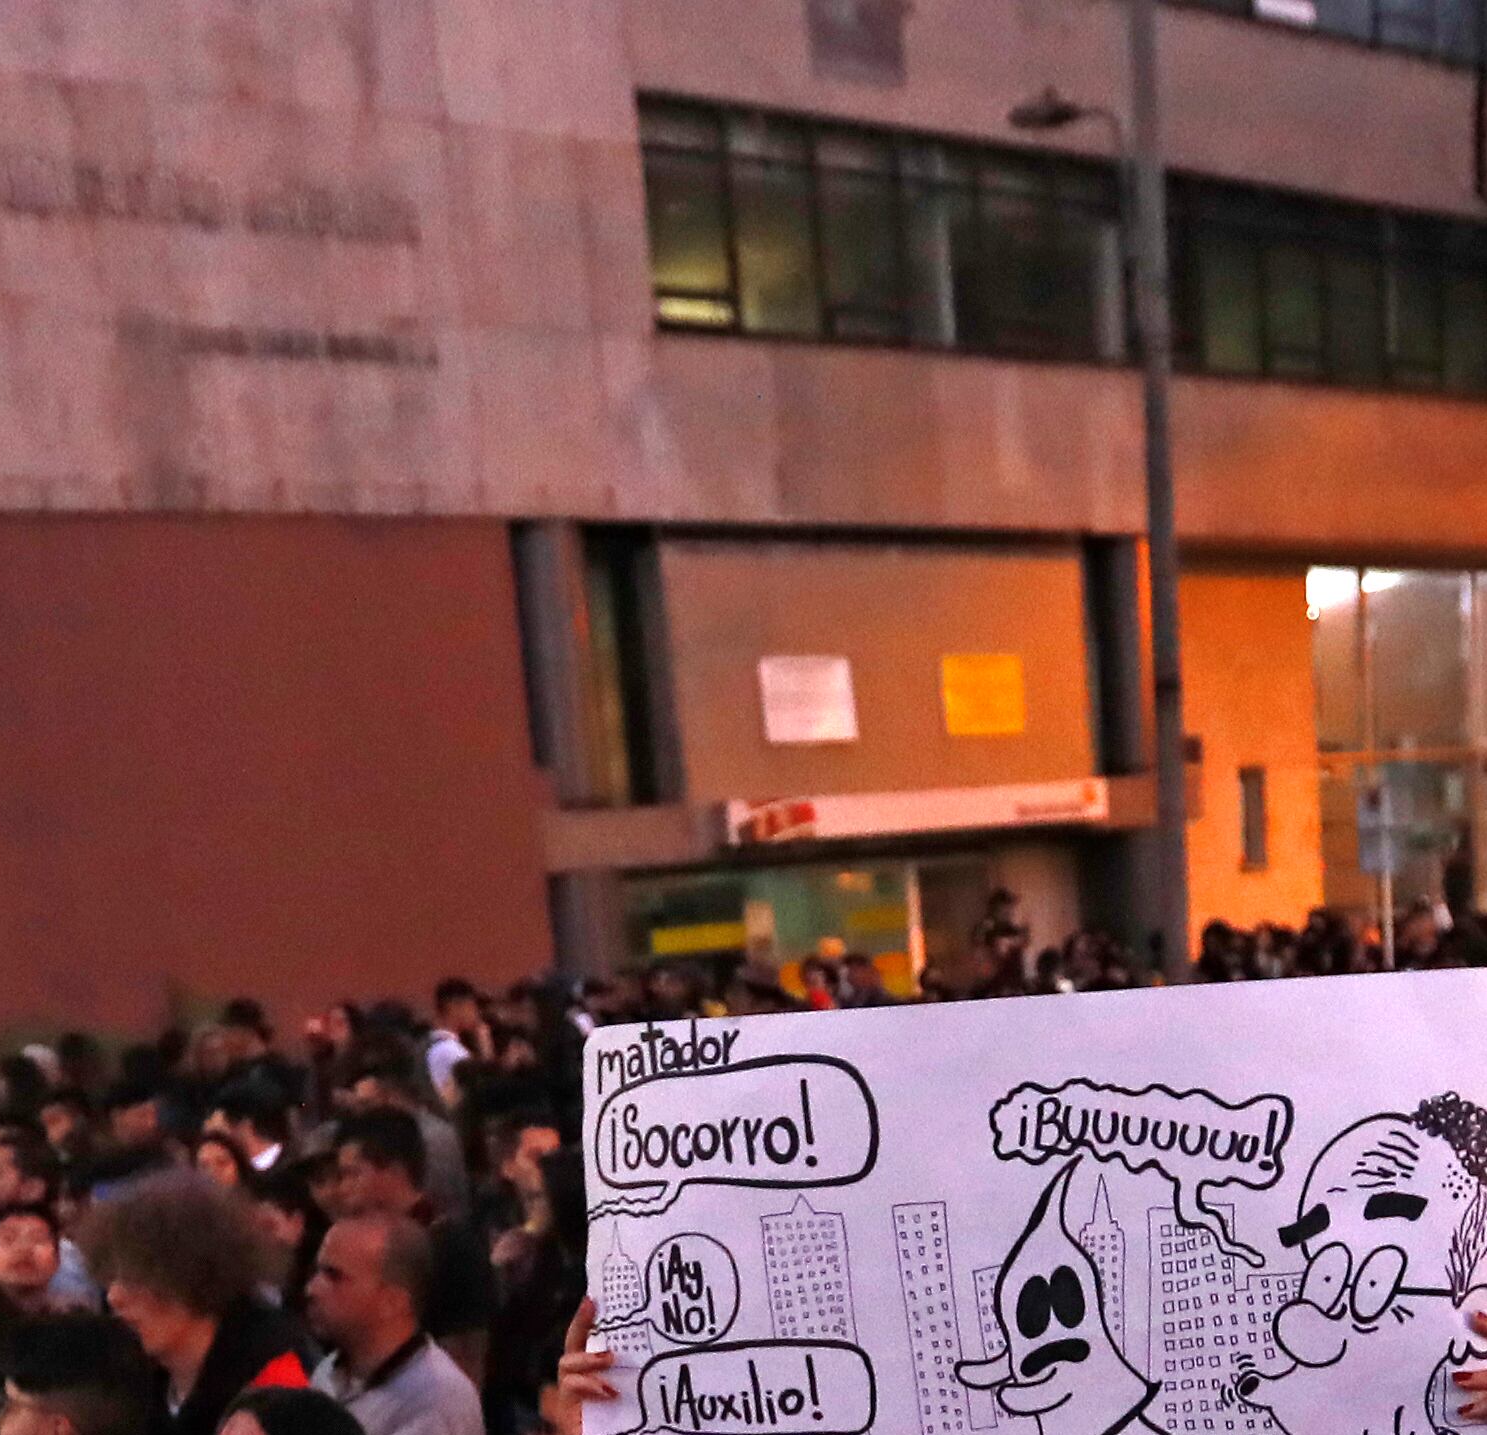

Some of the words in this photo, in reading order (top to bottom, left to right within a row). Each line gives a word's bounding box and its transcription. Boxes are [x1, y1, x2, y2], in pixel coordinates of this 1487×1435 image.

[597, 1019, 740, 1095] matador
[611, 1079, 818, 1173] ¡Socorro!
[659, 1243, 705, 1300] ¡Ay
[659, 1354, 824, 1431] ¡Auxilio!
